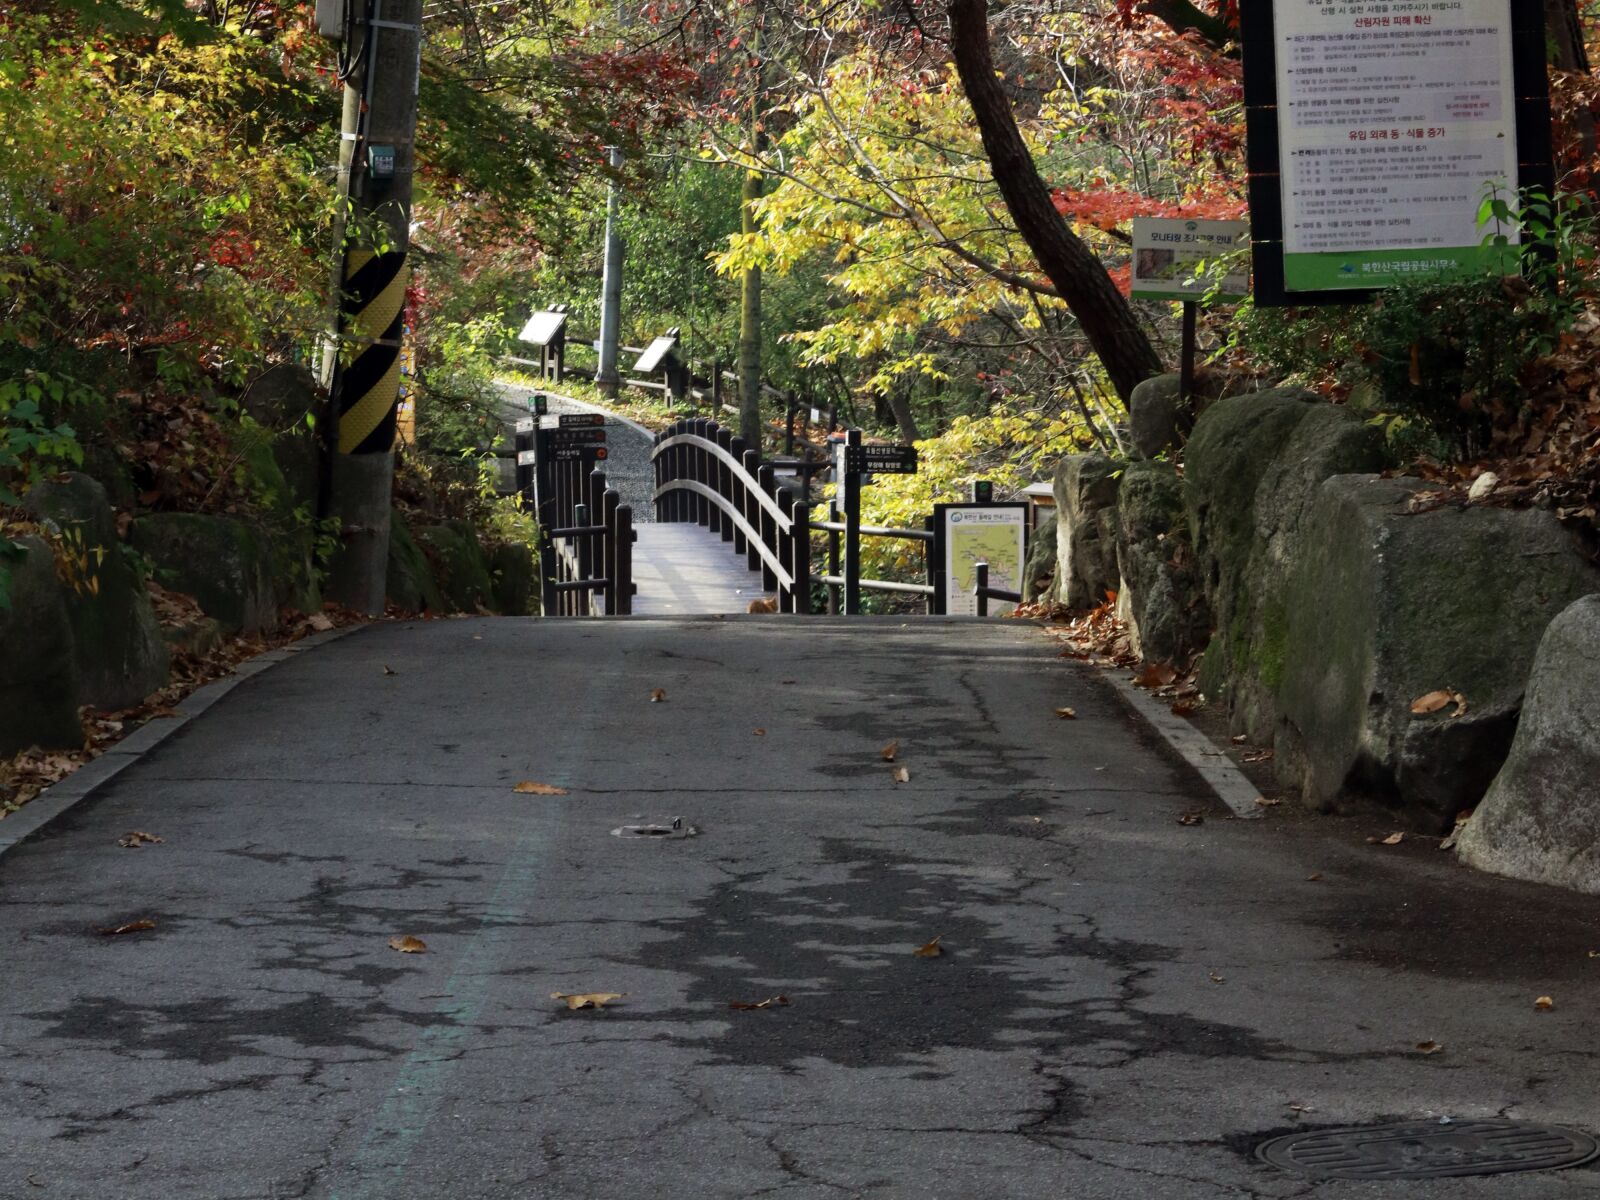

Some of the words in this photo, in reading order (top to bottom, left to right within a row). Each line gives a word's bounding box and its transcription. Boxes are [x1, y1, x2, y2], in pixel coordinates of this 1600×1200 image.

[1321, 6, 1335, 16] 산행
[1339, 6, 1346, 14] 시
[1349, 5, 1364, 14] 실천
[1367, 4, 1389, 13] 사항을
[1392, 2, 1429, 12] 지켜주시기
[1355, 17, 1390, 28] 산림자원
[1393, 15, 1411, 26] 피해
[1413, 14, 1431, 25] 확산
[1349, 130, 1366, 141] 유입
[1370, 129, 1387, 140] 외래
[1427, 127, 1445, 137] 증가
[1151, 232, 1181, 243] 모니터링
[1216, 235, 1232, 244] 안내
[1362, 259, 1458, 273] 북한산국립공원사무소
